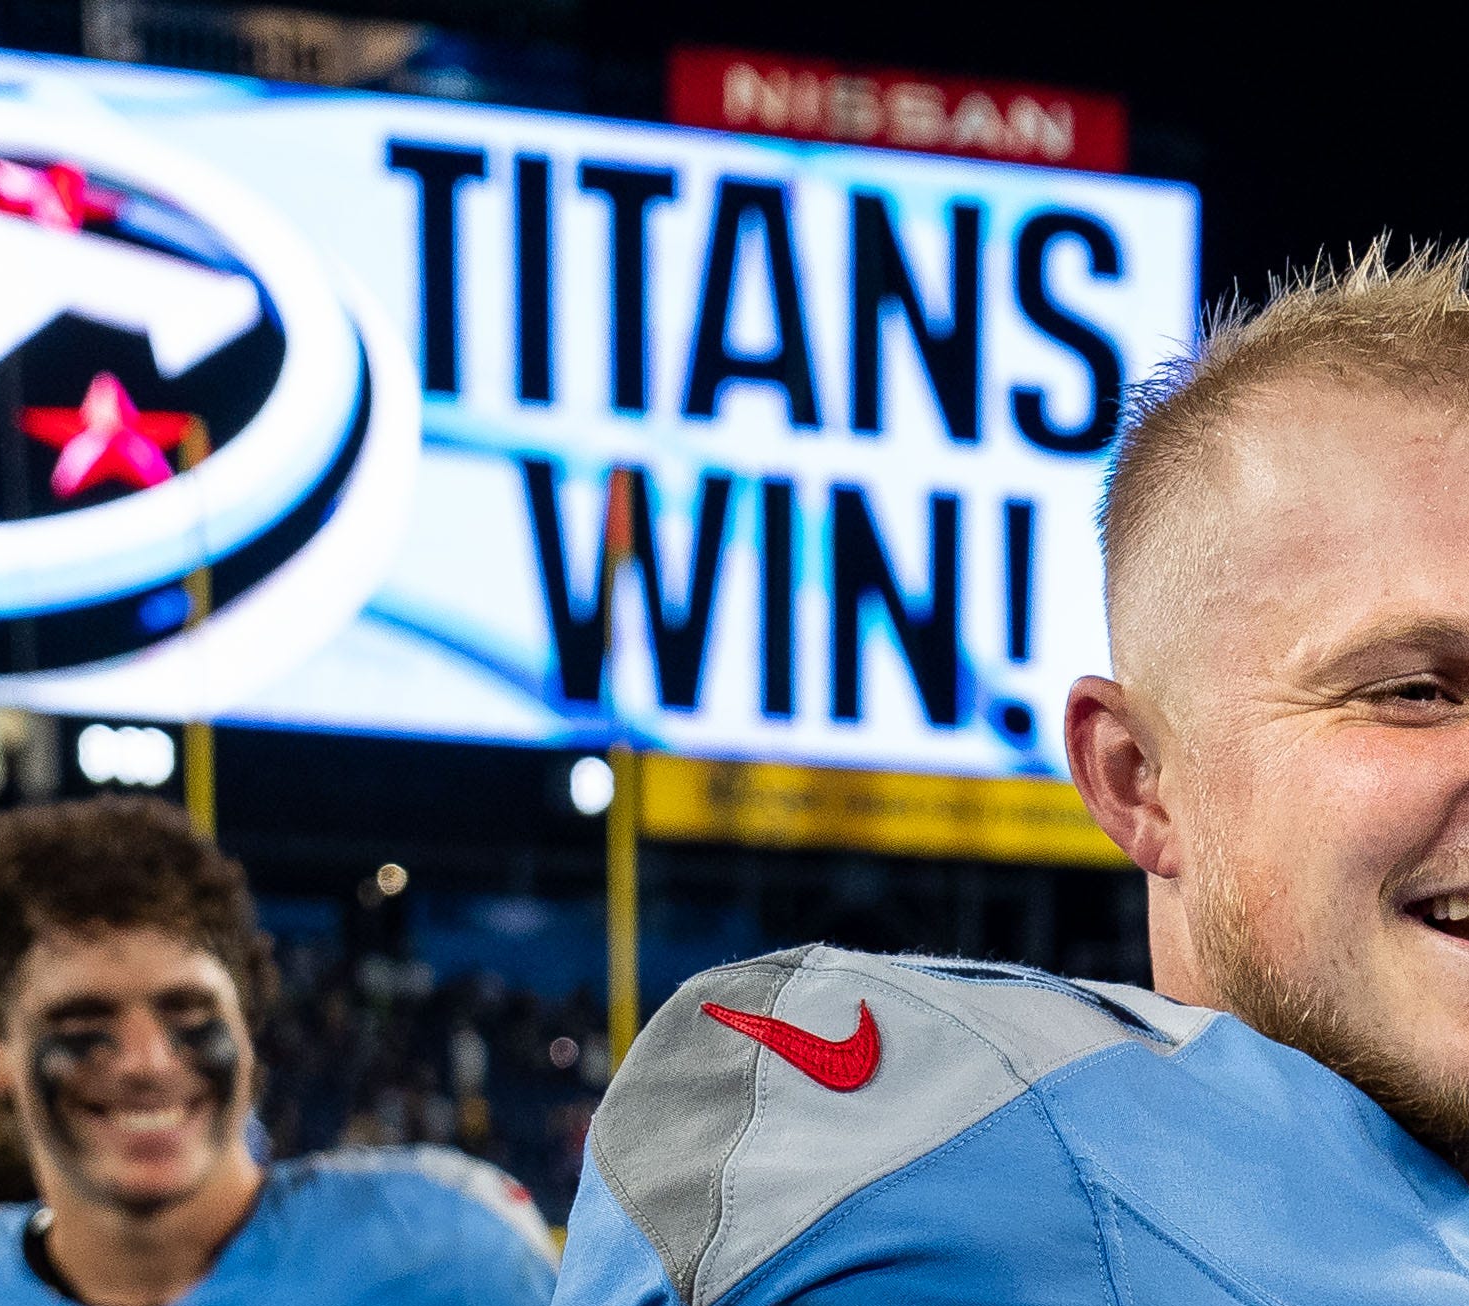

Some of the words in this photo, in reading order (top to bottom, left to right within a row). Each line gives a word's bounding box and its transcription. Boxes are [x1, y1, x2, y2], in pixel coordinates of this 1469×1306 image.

[723, 62, 1075, 161] NISSAN
[388, 138, 1124, 455] TITANS
[521, 458, 1037, 736] WIN!
